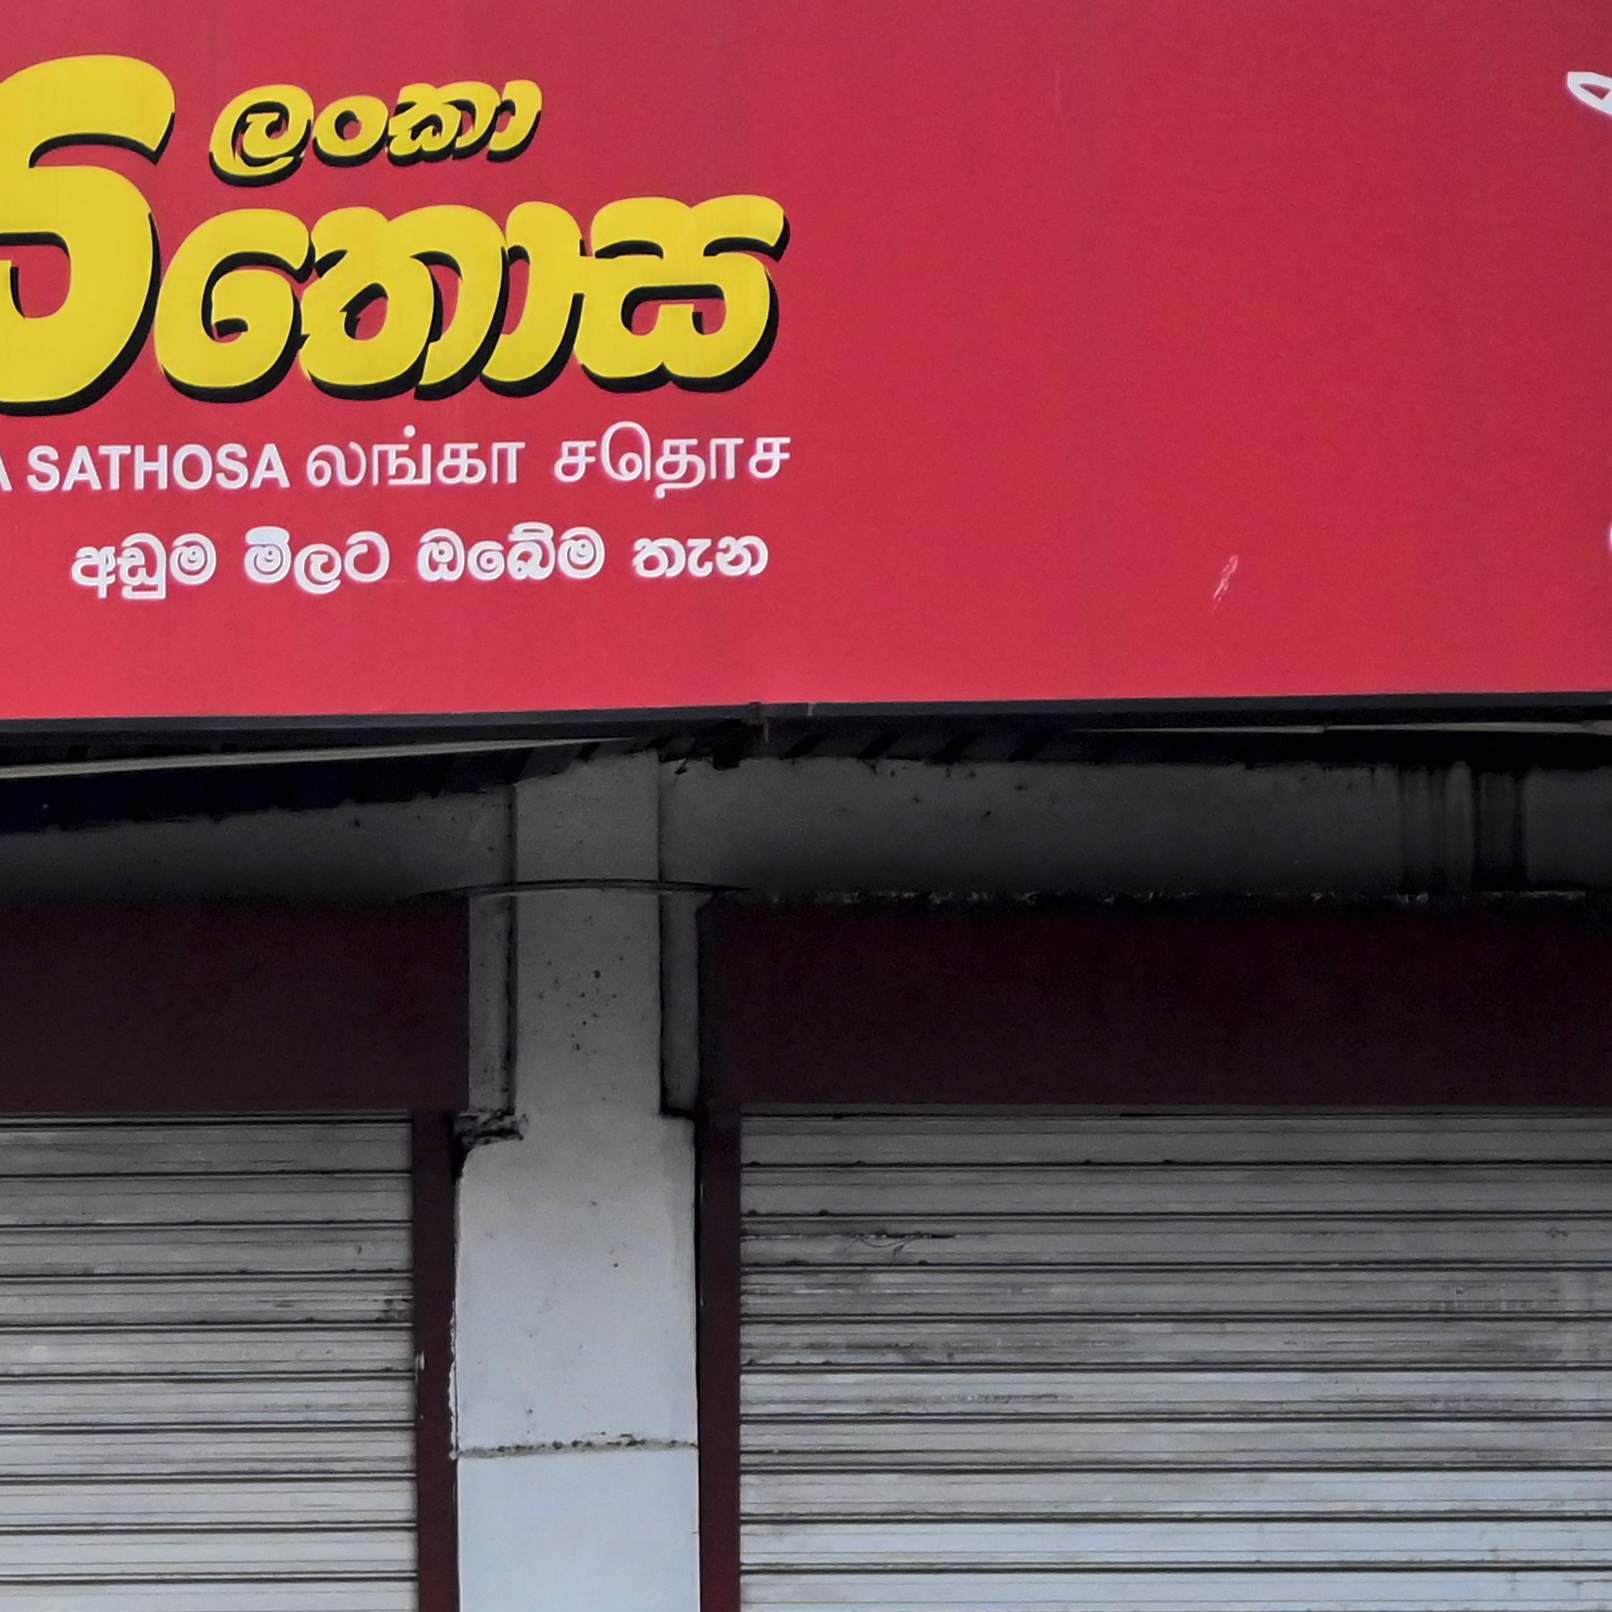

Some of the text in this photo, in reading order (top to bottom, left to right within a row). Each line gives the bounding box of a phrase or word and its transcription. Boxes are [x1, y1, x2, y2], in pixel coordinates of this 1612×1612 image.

[209, 79, 545, 182] ලංකා
[28, 443, 292, 494] SATHOSA
[306, 421, 793, 501] லங்கா சதொச
[71, 521, 770, 601] අඩුම මිලට ඔබේම තැන
